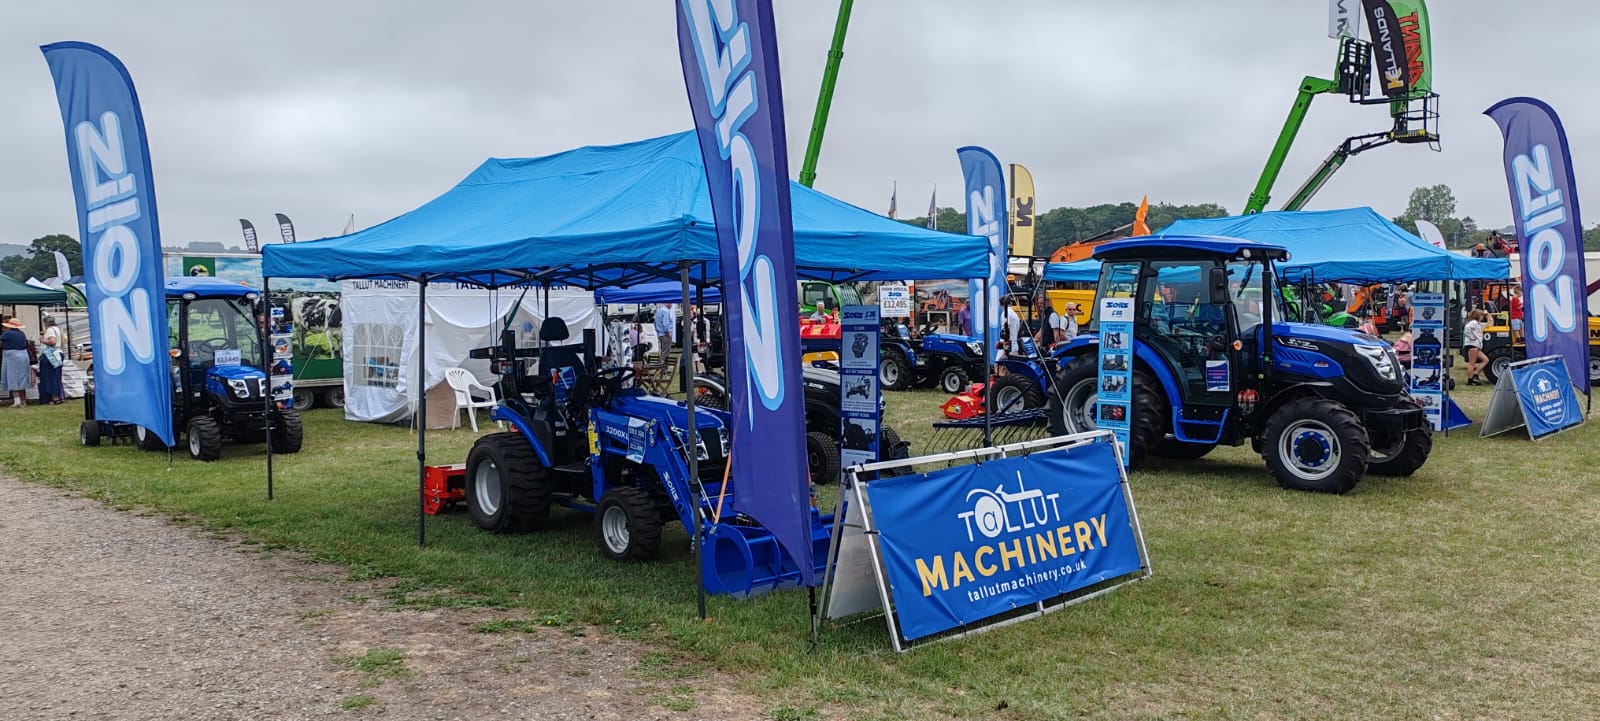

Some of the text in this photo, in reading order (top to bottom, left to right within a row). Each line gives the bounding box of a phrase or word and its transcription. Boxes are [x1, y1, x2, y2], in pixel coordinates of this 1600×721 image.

[1373, 6, 1404, 90] KELLANDS
[352, 280, 410, 290] TALLUT MACHINERY
[883, 300, 907, 309] £12,495
[914, 513, 1109, 598] MACHINERY
[967, 559, 1088, 602] tallutmachinery.co.uk
